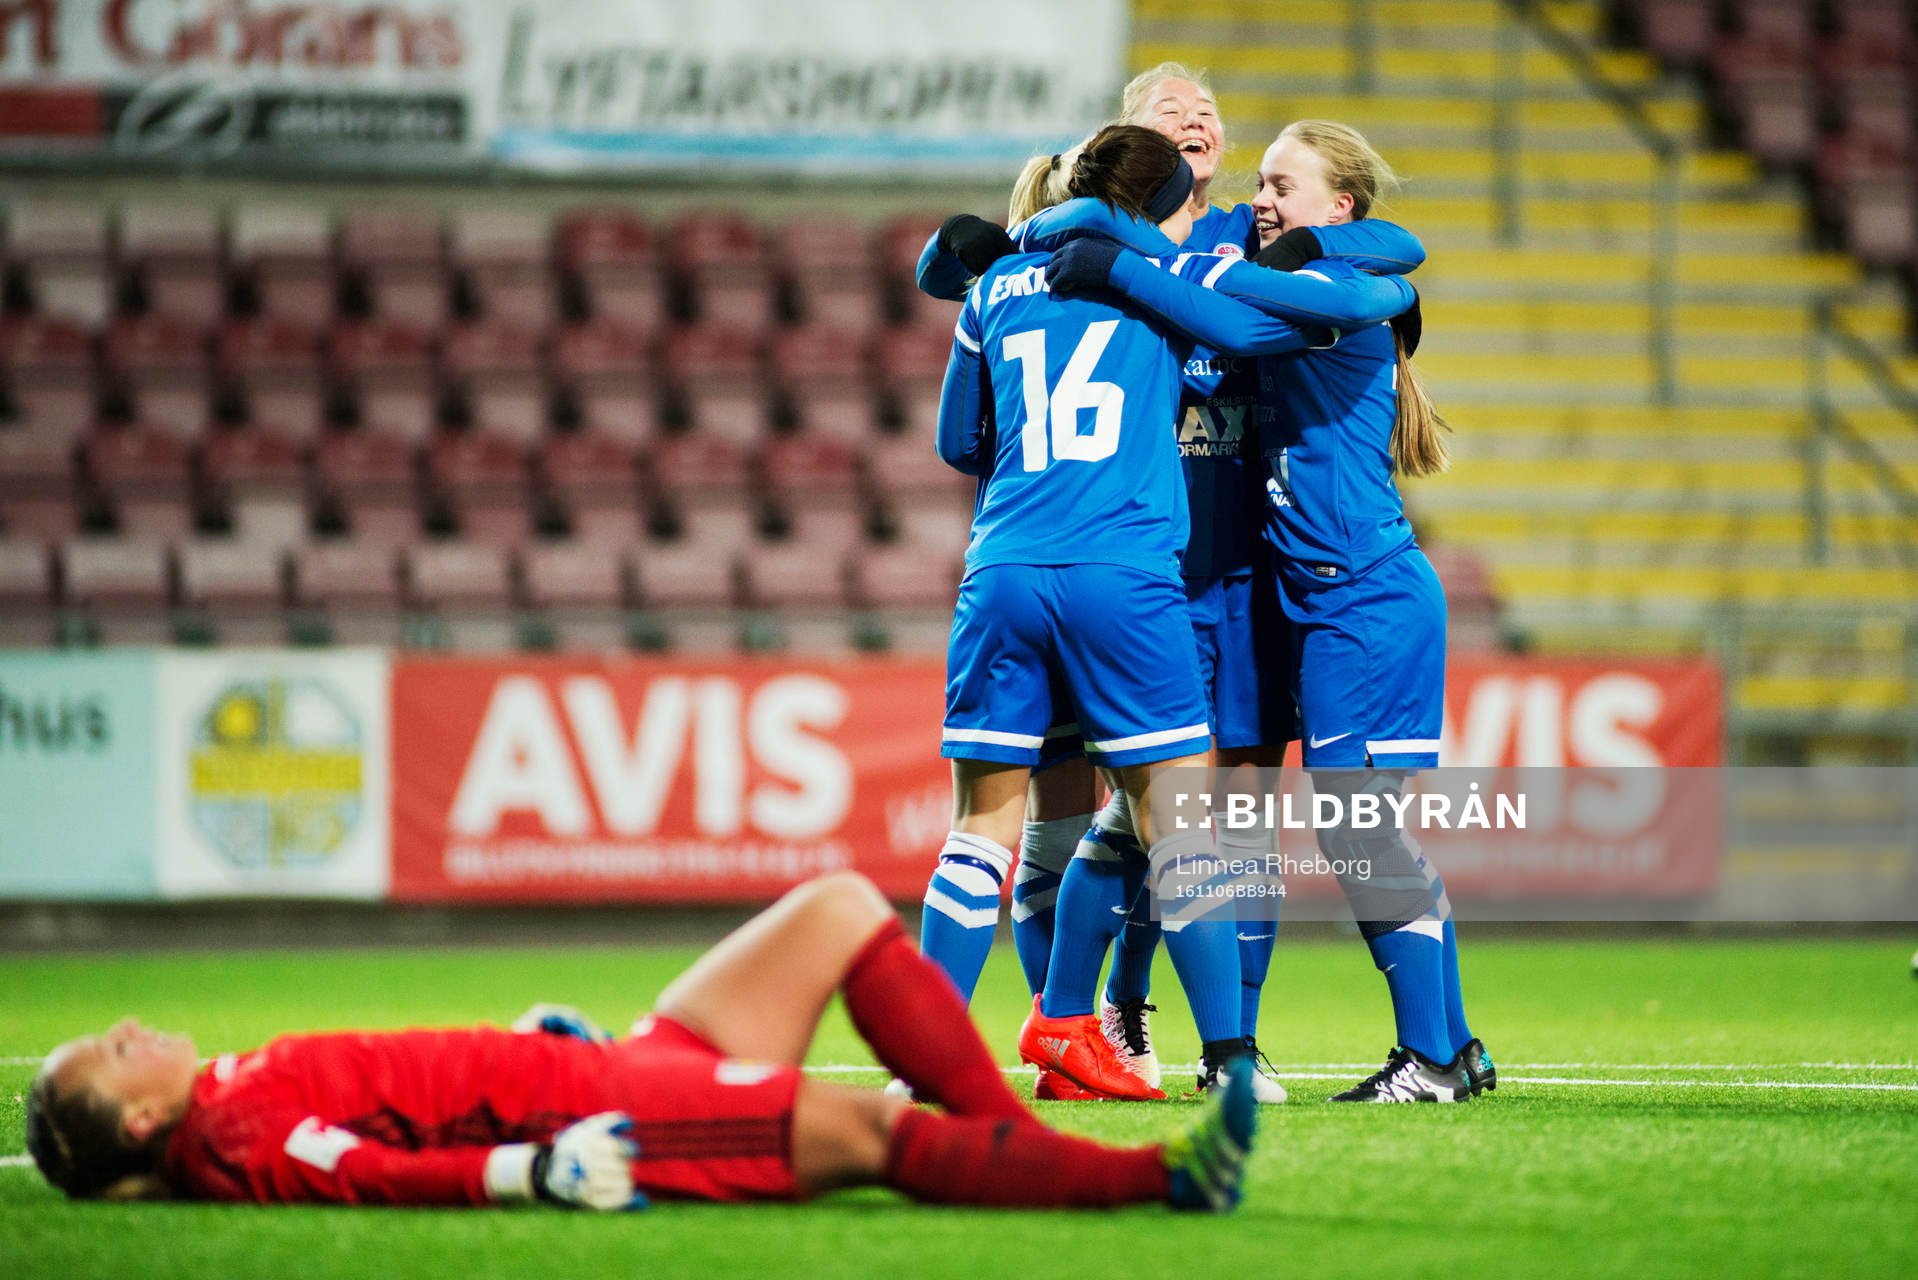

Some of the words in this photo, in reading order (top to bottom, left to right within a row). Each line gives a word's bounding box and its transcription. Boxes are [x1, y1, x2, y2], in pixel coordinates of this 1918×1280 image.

[987, 265, 1051, 305] ESKI
[1003, 320, 1124, 473] 16
[448, 674, 854, 837] AVIS
[1410, 672, 1669, 838] VIS
